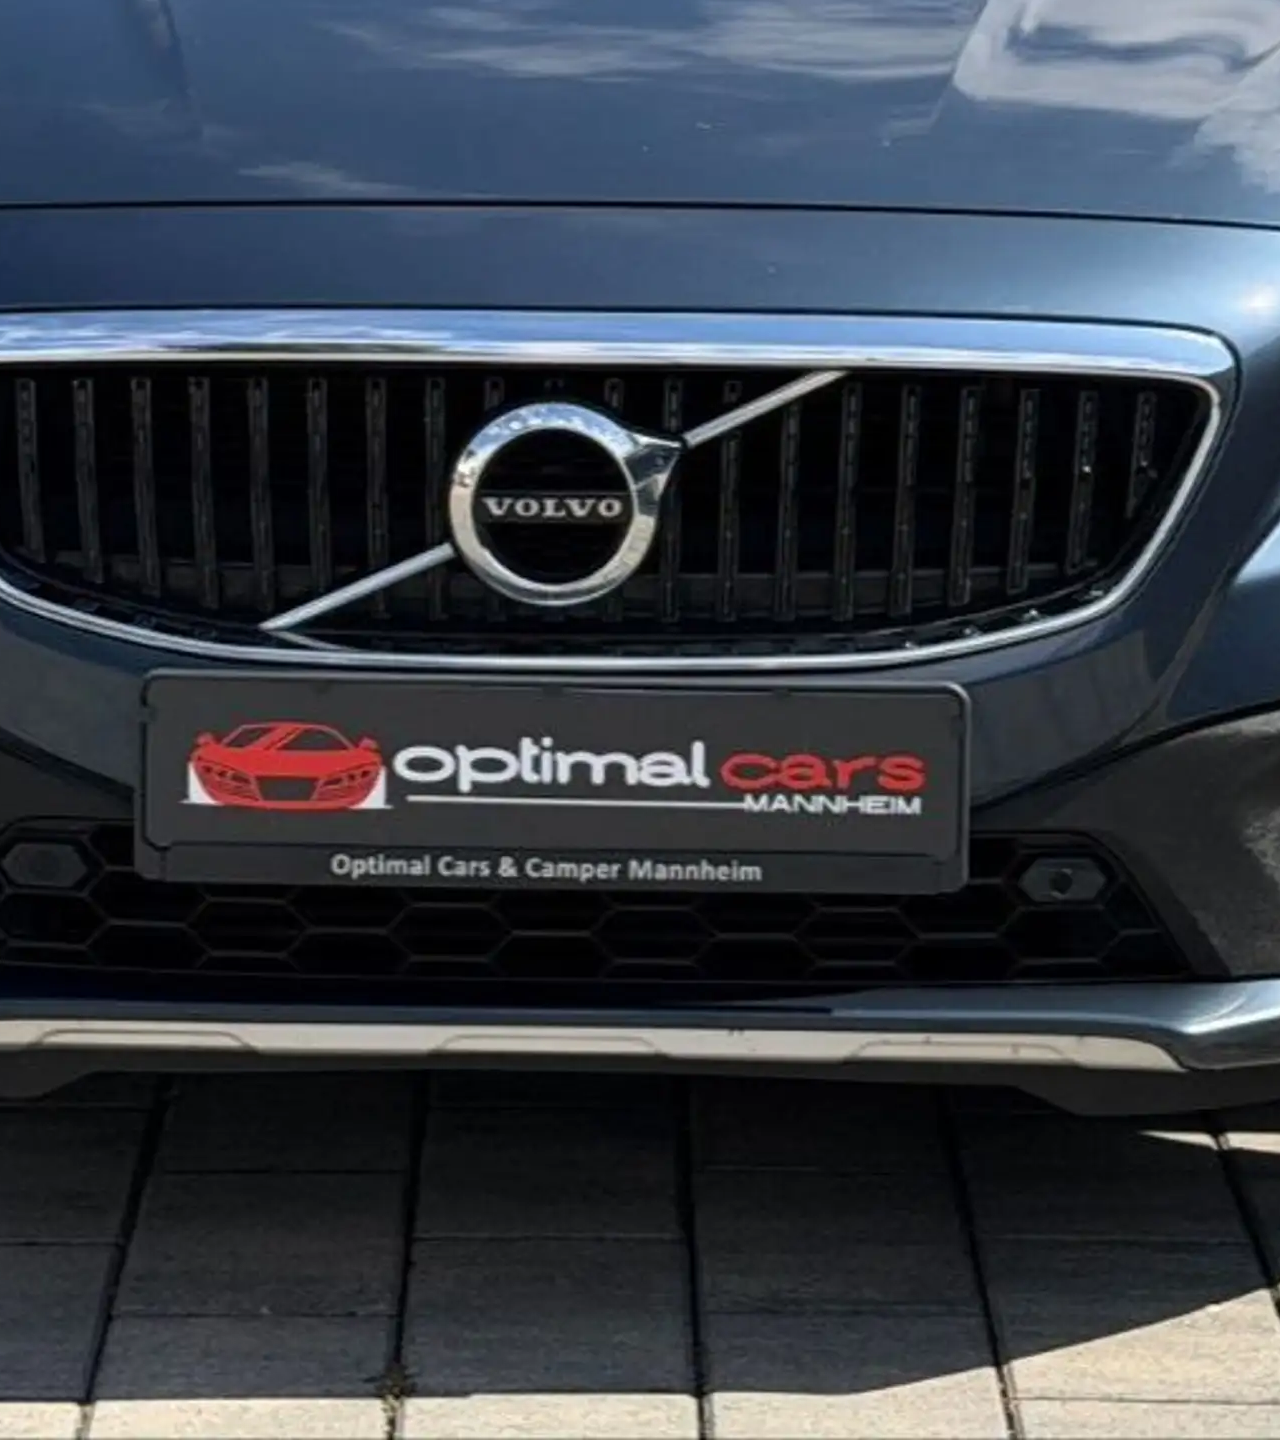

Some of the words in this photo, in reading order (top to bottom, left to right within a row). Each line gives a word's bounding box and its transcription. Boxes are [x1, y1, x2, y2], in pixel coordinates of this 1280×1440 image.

[482, 496, 623, 518] VOLVO
[393, 737, 710, 795] optimal
[721, 747, 927, 792] cars
[744, 793, 923, 816] MANNHEIM
[331, 853, 431, 882] Optimal
[438, 855, 490, 879] Cars
[497, 857, 517, 880] &
[524, 857, 622, 885] Camper
[629, 857, 762, 883] Mannheim
